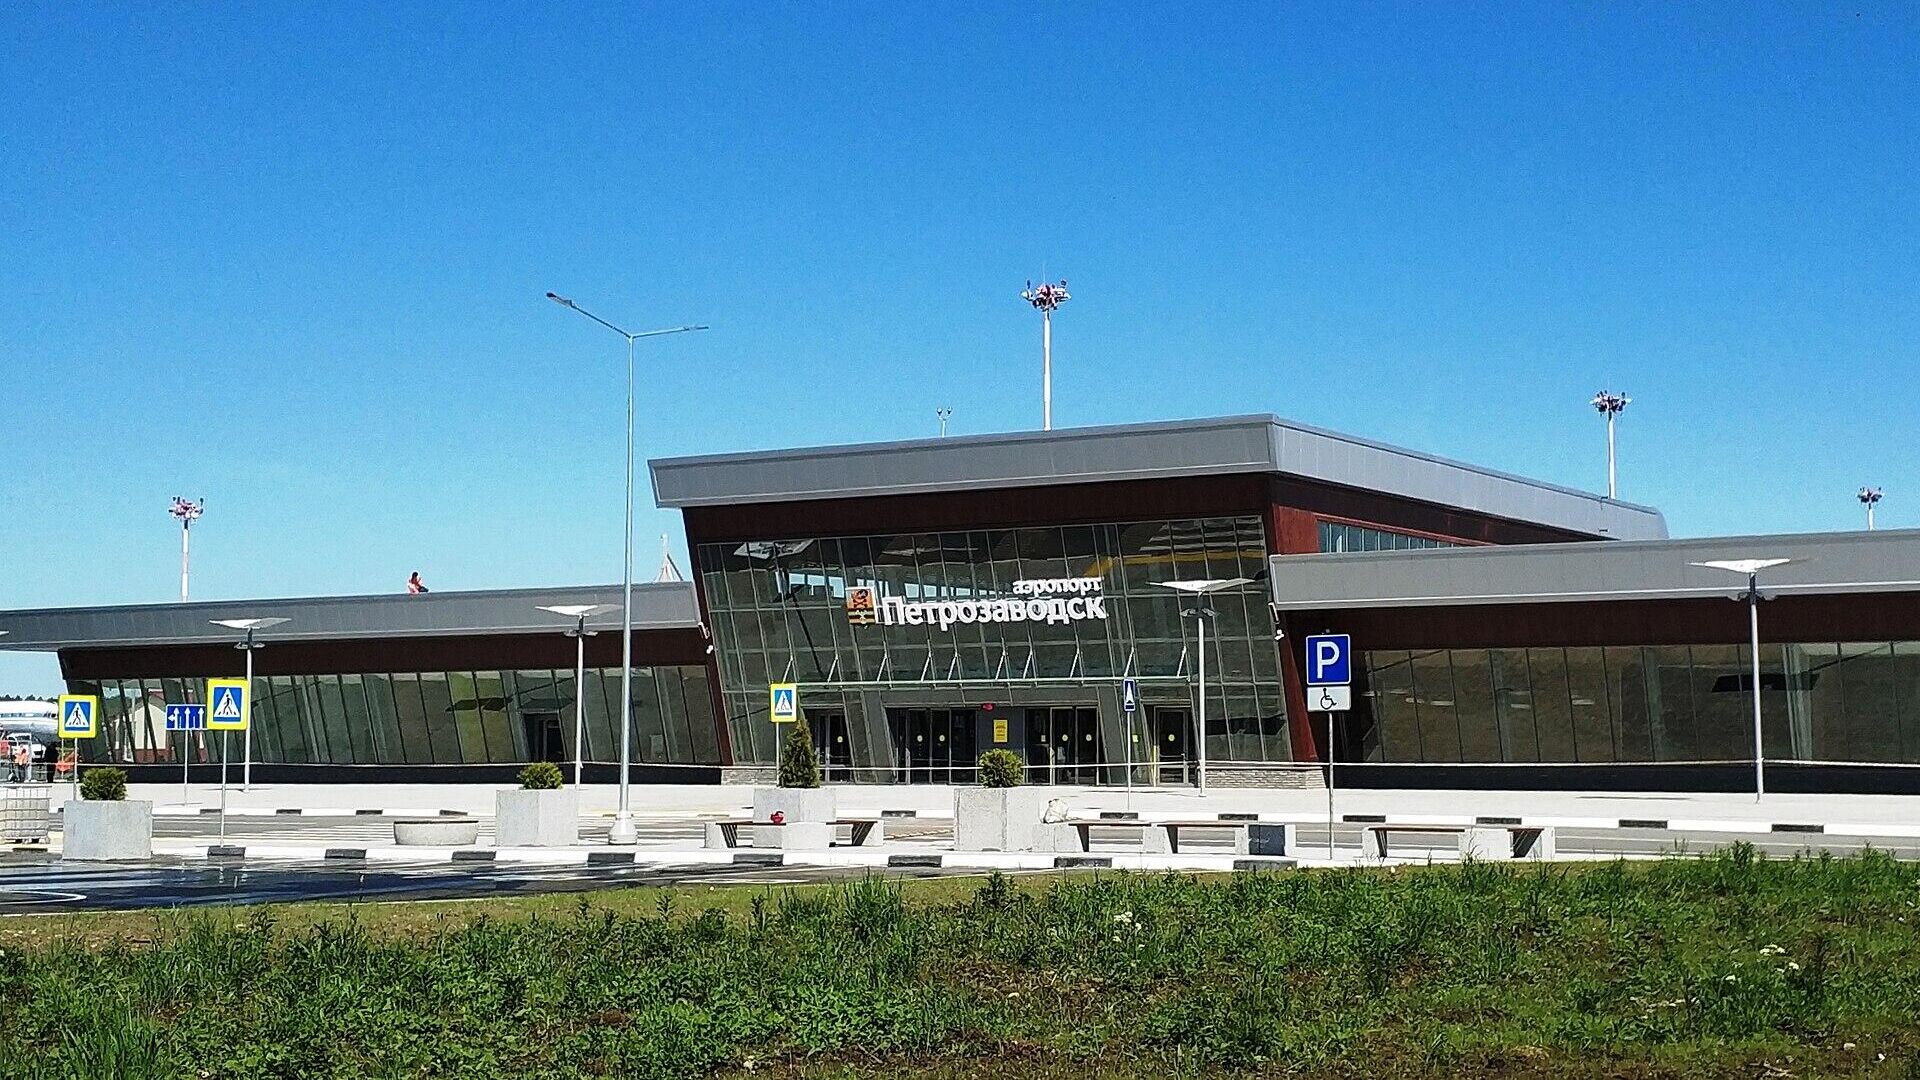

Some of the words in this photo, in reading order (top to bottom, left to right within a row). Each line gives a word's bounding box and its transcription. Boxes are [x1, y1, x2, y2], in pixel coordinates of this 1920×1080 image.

[1012, 577, 1103, 596] аэропорт
[882, 596, 1108, 631] Петрозаводск
[1317, 641, 1340, 678] P
